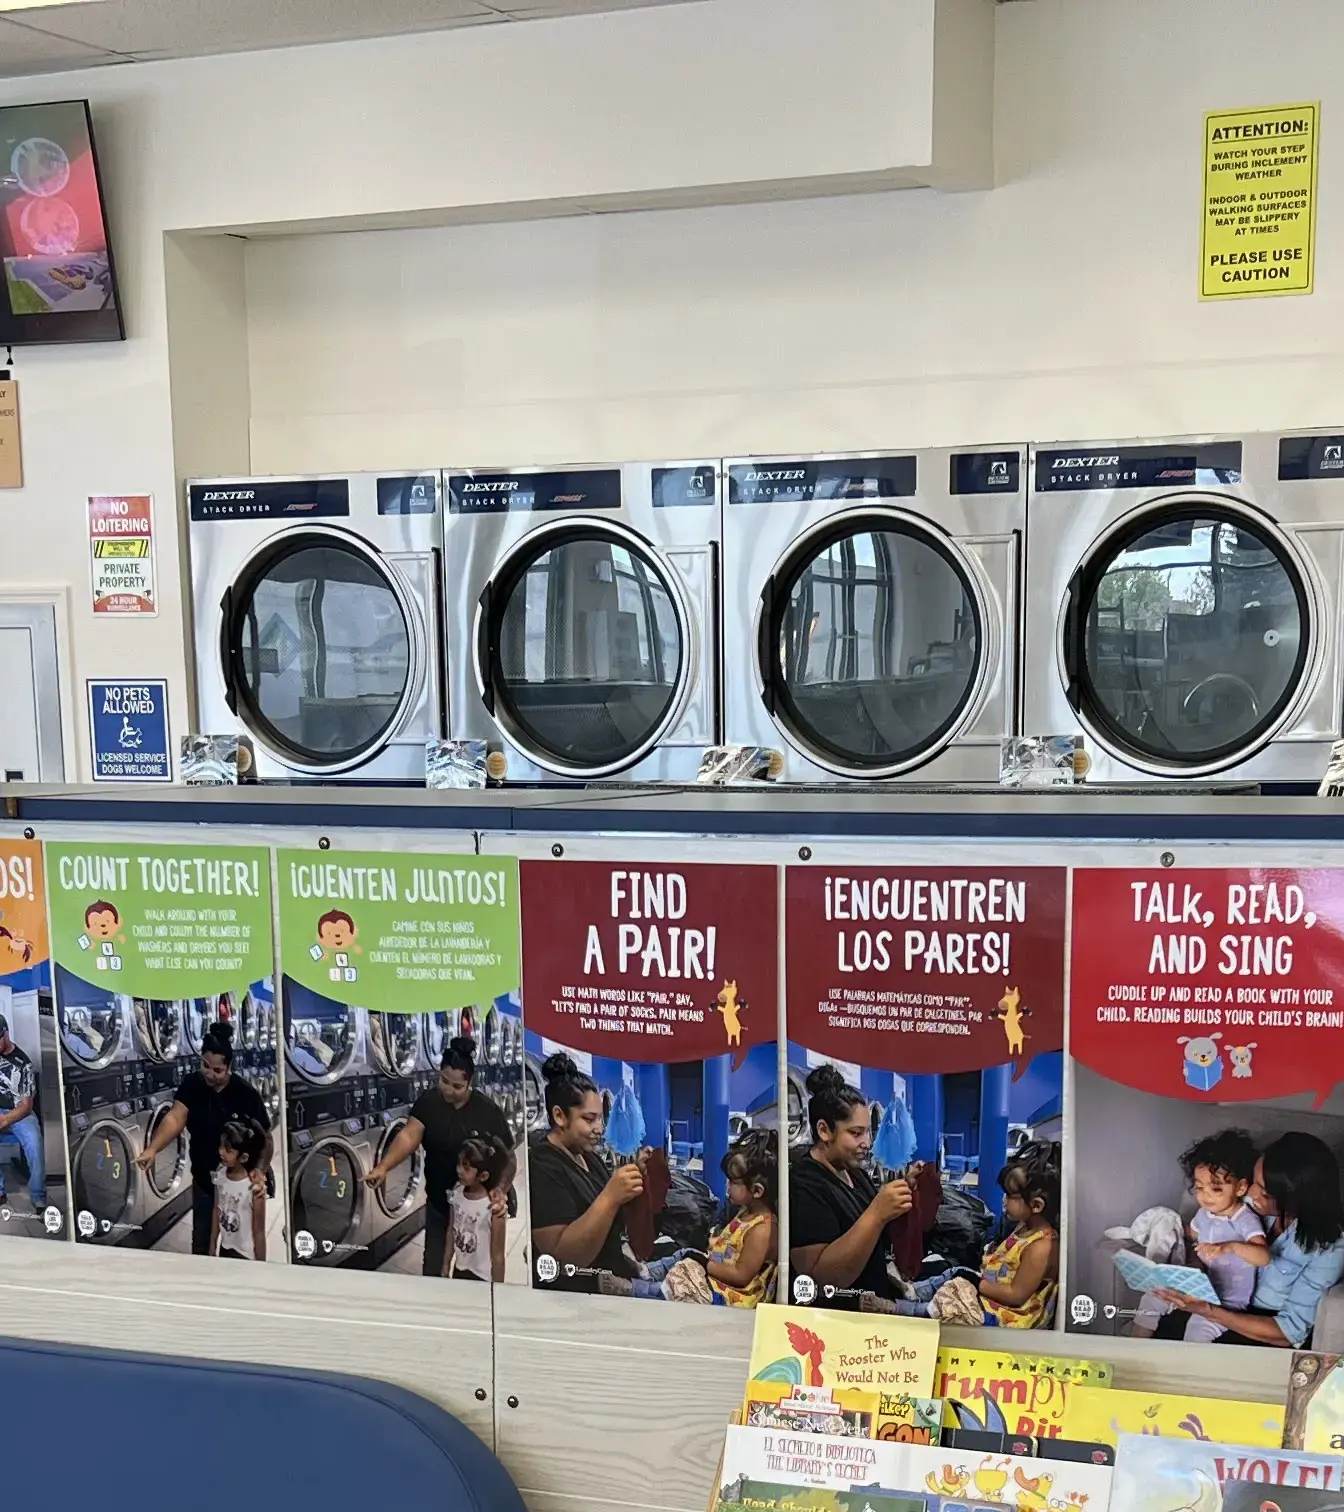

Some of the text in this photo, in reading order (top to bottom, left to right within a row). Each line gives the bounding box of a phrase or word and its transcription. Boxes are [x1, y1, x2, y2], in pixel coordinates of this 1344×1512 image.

[1212, 120, 1309, 141] ATTENTION:
[1214, 144, 1306, 161] WATCH YOUR STEP
[1211, 155, 1308, 172] DURING INCLEMENT
[1235, 169, 1282, 180] WEATHER
[1211, 249, 1303, 266] PLEASE USE
[1222, 267, 1290, 282] CAUTION
[1051, 456, 1120, 468] DEXTER
[203, 490, 255, 501] DEXTER
[110, 501, 128, 515] NO
[92, 518, 148, 533] LOITERING
[104, 564, 140, 574] PRIVATE
[99, 577, 146, 588] PROPERTY
[105, 687, 150, 700] NO PETS
[103, 701, 154, 714] ALLOWED
[97, 752, 166, 762] LICENSED SERVICE
[102, 764, 162, 774] DOGS WELCOME
[59, 856, 259, 897] COUNT TOGETHER!
[291, 863, 506, 906] ¡CUENTEN JUNTOS!
[610, 871, 687, 920] FIND
[824, 877, 1026, 923] ¡ENCUENTREN
[1130, 881, 1317, 929] TALK, READ,
[583, 925, 716, 981] A PAIR!
[838, 931, 1010, 975] LOS PARES!
[1147, 936, 1293, 975] AND SING
[1097, 1007, 1344, 1028] CHILD. READING BUILDS YOUR CHILD'S BRAIN!
[864, 1335, 889, 1351] The
[838, 1347, 917, 1367] Rooster Who
[835, 1368, 919, 1384] Would Not Be
